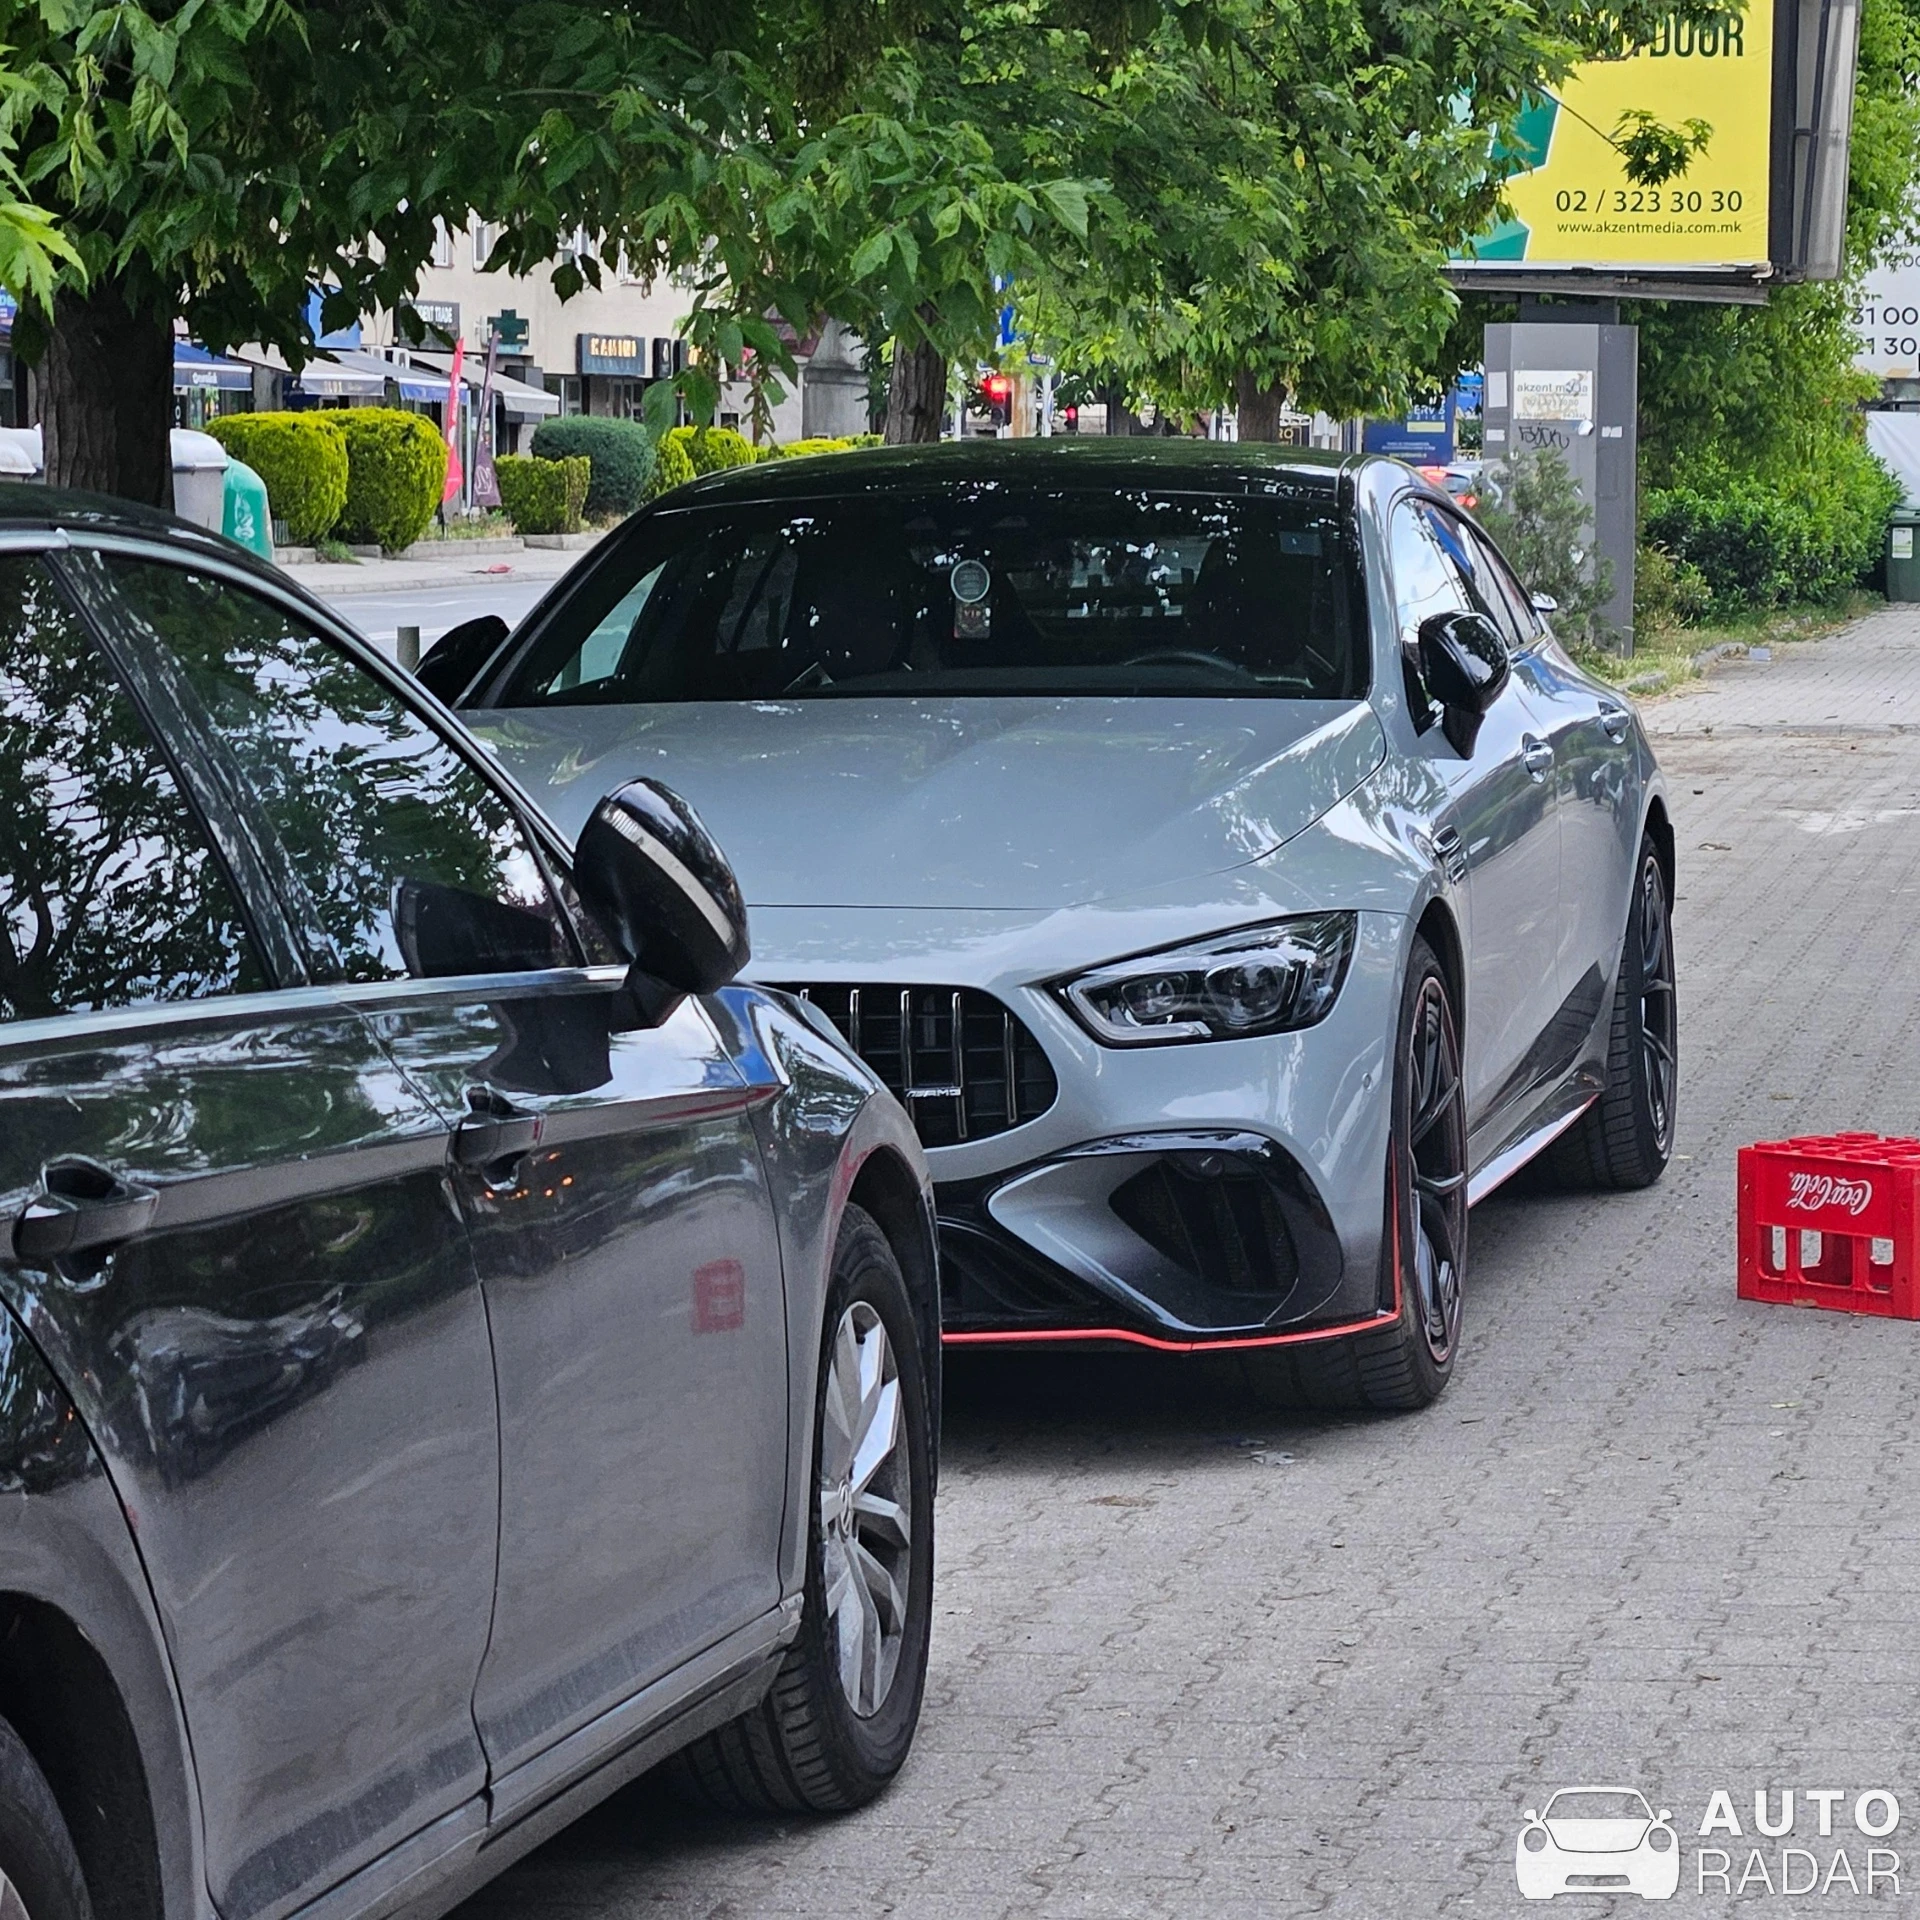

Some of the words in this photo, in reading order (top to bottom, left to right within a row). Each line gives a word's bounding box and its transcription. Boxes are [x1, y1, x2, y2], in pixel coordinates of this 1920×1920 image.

[1556, 190, 1587, 212] 02
[1596, 189, 1606, 213] /
[1613, 191, 1661, 212] 323
[1670, 191, 1702, 213] 30
[1710, 190, 1743, 212] 30
[1557, 221, 1742, 233] www.akzentmedia.com.mk
[924, 1088, 961, 1098] AMG
[1785, 1171, 1873, 1216] Coca-Cola
